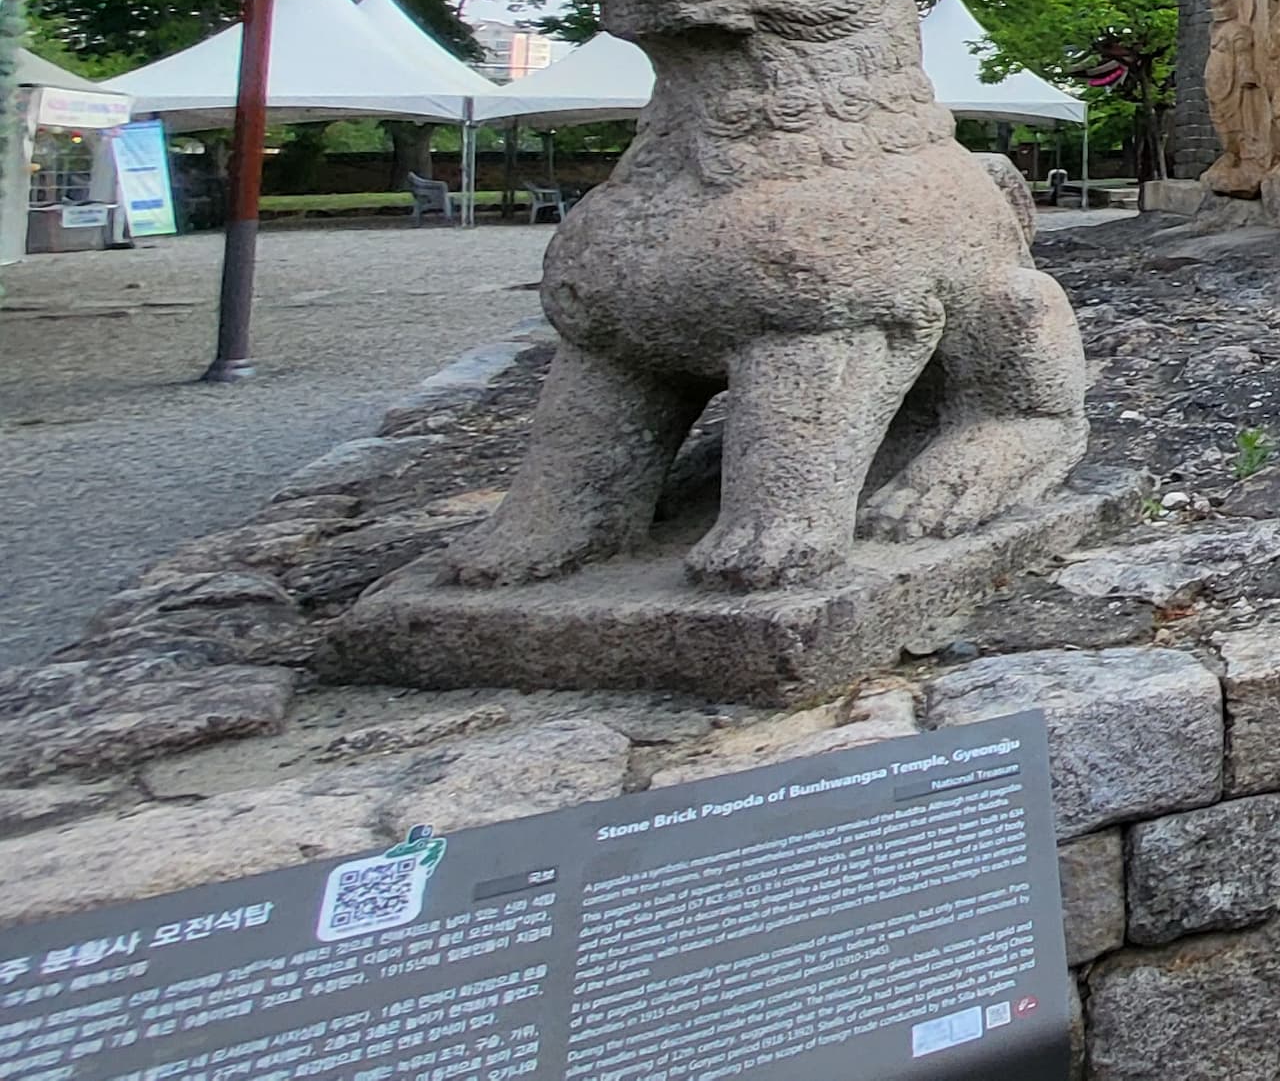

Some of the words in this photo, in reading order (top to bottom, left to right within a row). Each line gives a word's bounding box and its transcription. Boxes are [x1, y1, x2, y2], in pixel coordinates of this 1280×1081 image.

[597, 819, 650, 841] Stone
[653, 807, 697, 828] Brick
[701, 794, 764, 819] Pagoda
[767, 786, 786, 803] of
[789, 768, 887, 798] Bunhwangsa
[890, 754, 950, 776] Temple,
[952, 737, 1021, 762] Gyeongju
[931, 772, 975, 791] National
[976, 763, 1019, 780] Treasure
[40, 929, 143, 975] 분황사
[149, 900, 275, 948] 모전석탑
[639, 1007, 664, 1023] 1915
